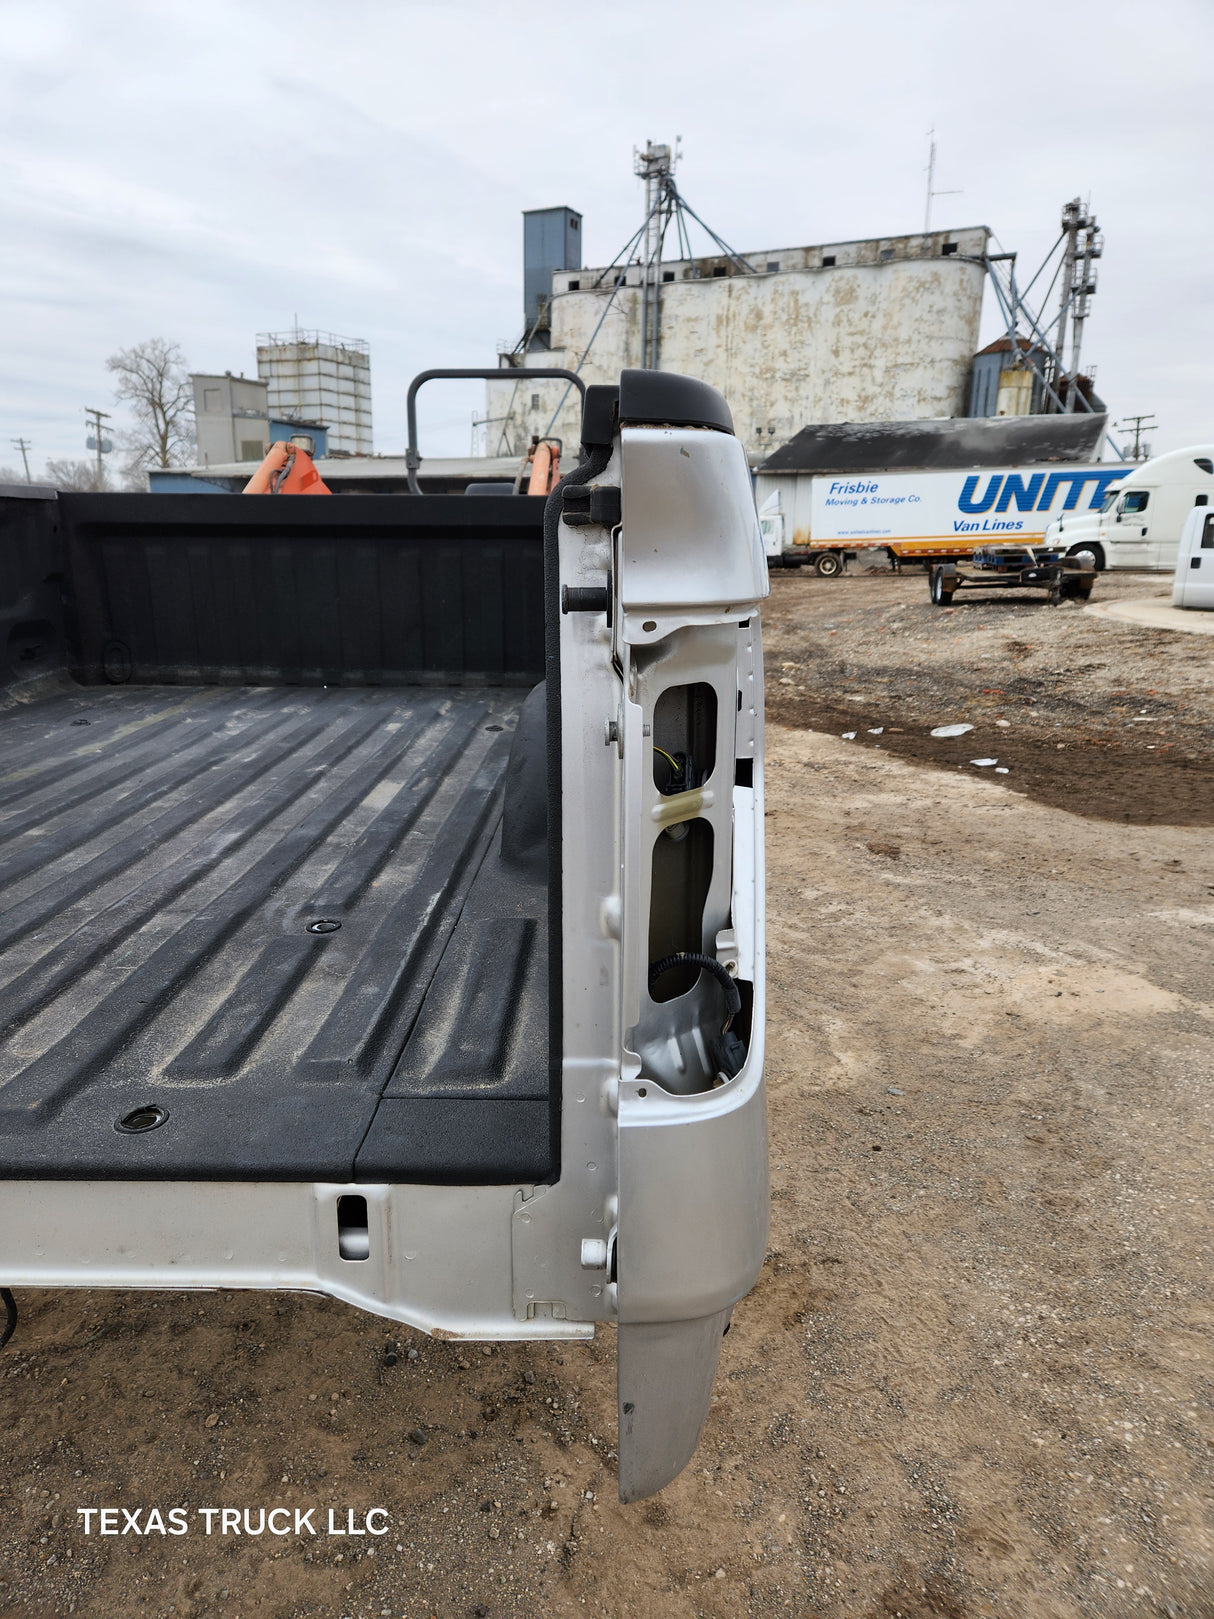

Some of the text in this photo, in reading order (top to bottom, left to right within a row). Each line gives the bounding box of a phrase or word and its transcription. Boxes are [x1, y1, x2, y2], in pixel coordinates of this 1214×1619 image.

[829, 480, 879, 494] Frisbie
[825, 498, 858, 507] Moving
[860, 497, 868, 505] &
[870, 496, 906, 505] Storage
[953, 518, 1024, 532] Van Lines
